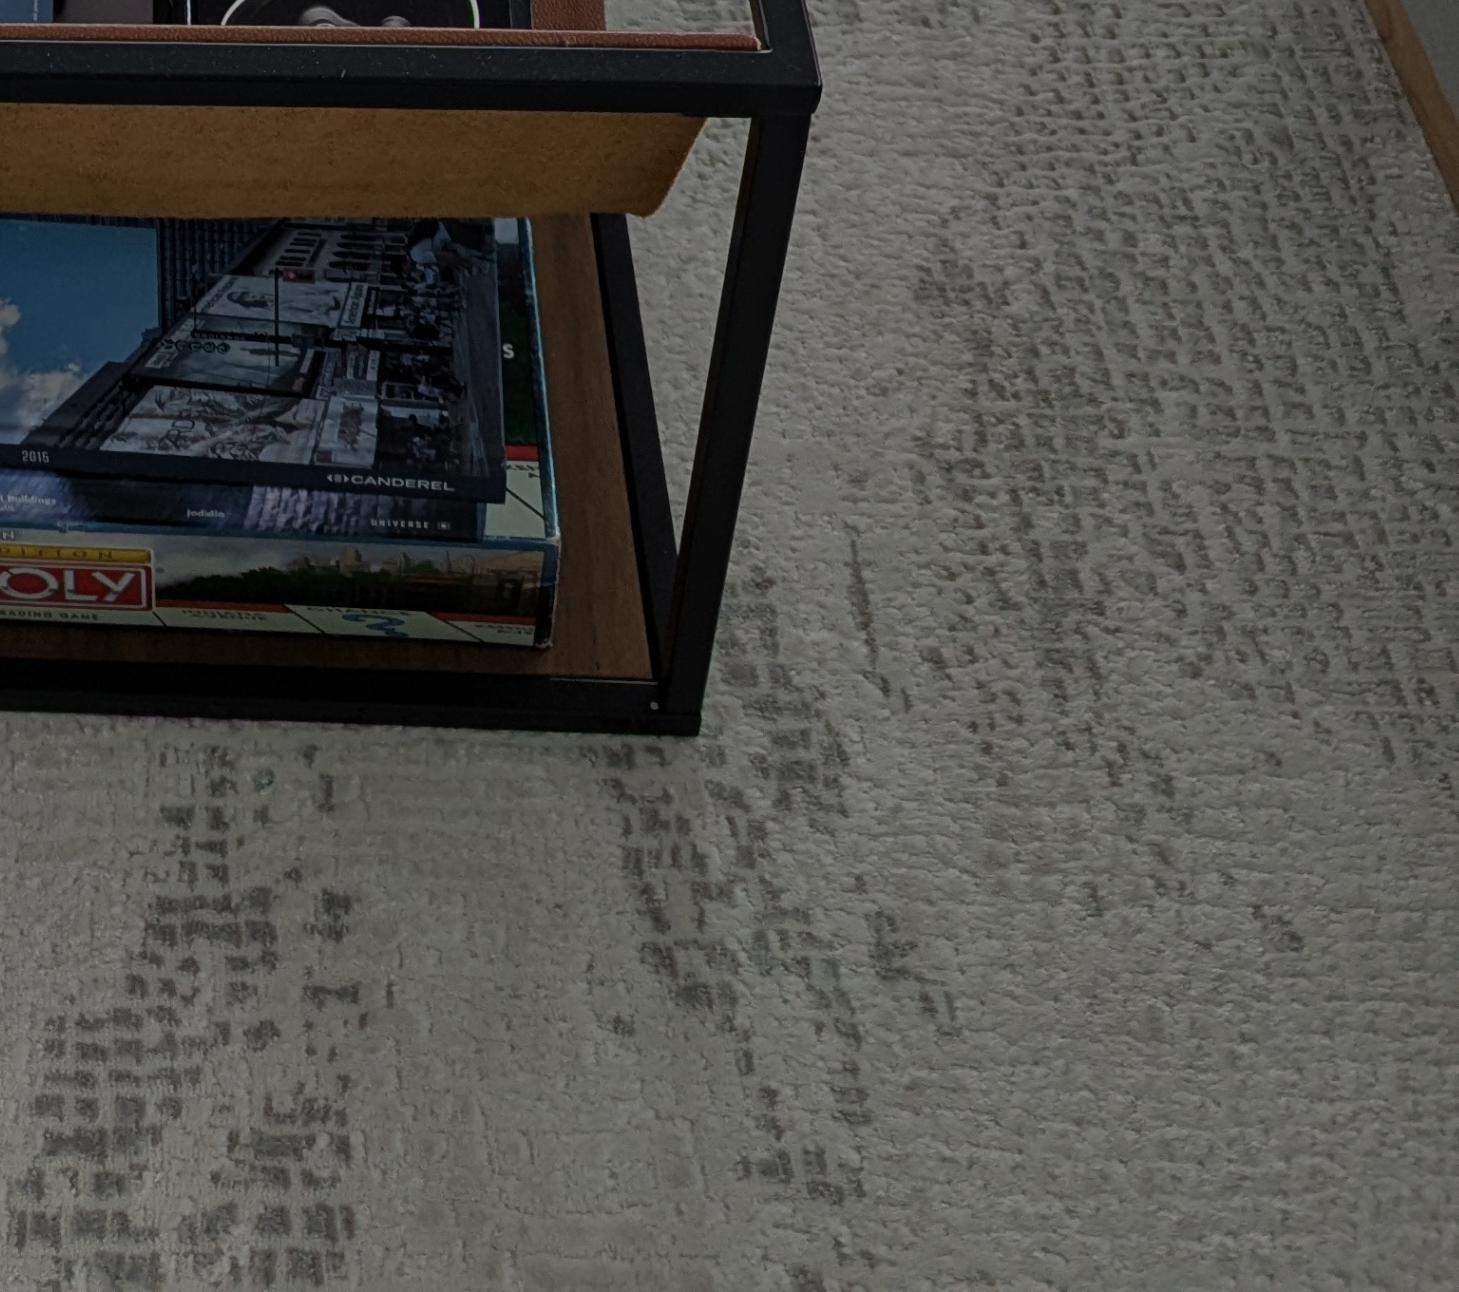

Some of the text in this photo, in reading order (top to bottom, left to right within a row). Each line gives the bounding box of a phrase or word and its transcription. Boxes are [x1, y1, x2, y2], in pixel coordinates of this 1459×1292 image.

[351, 475, 455, 492] CANDEREL
[7, 495, 57, 506] Buildings
[186, 508, 225, 519] Jodidio
[370, 519, 429, 529] UNIVERSE
[59, 612, 100, 622] GAME
